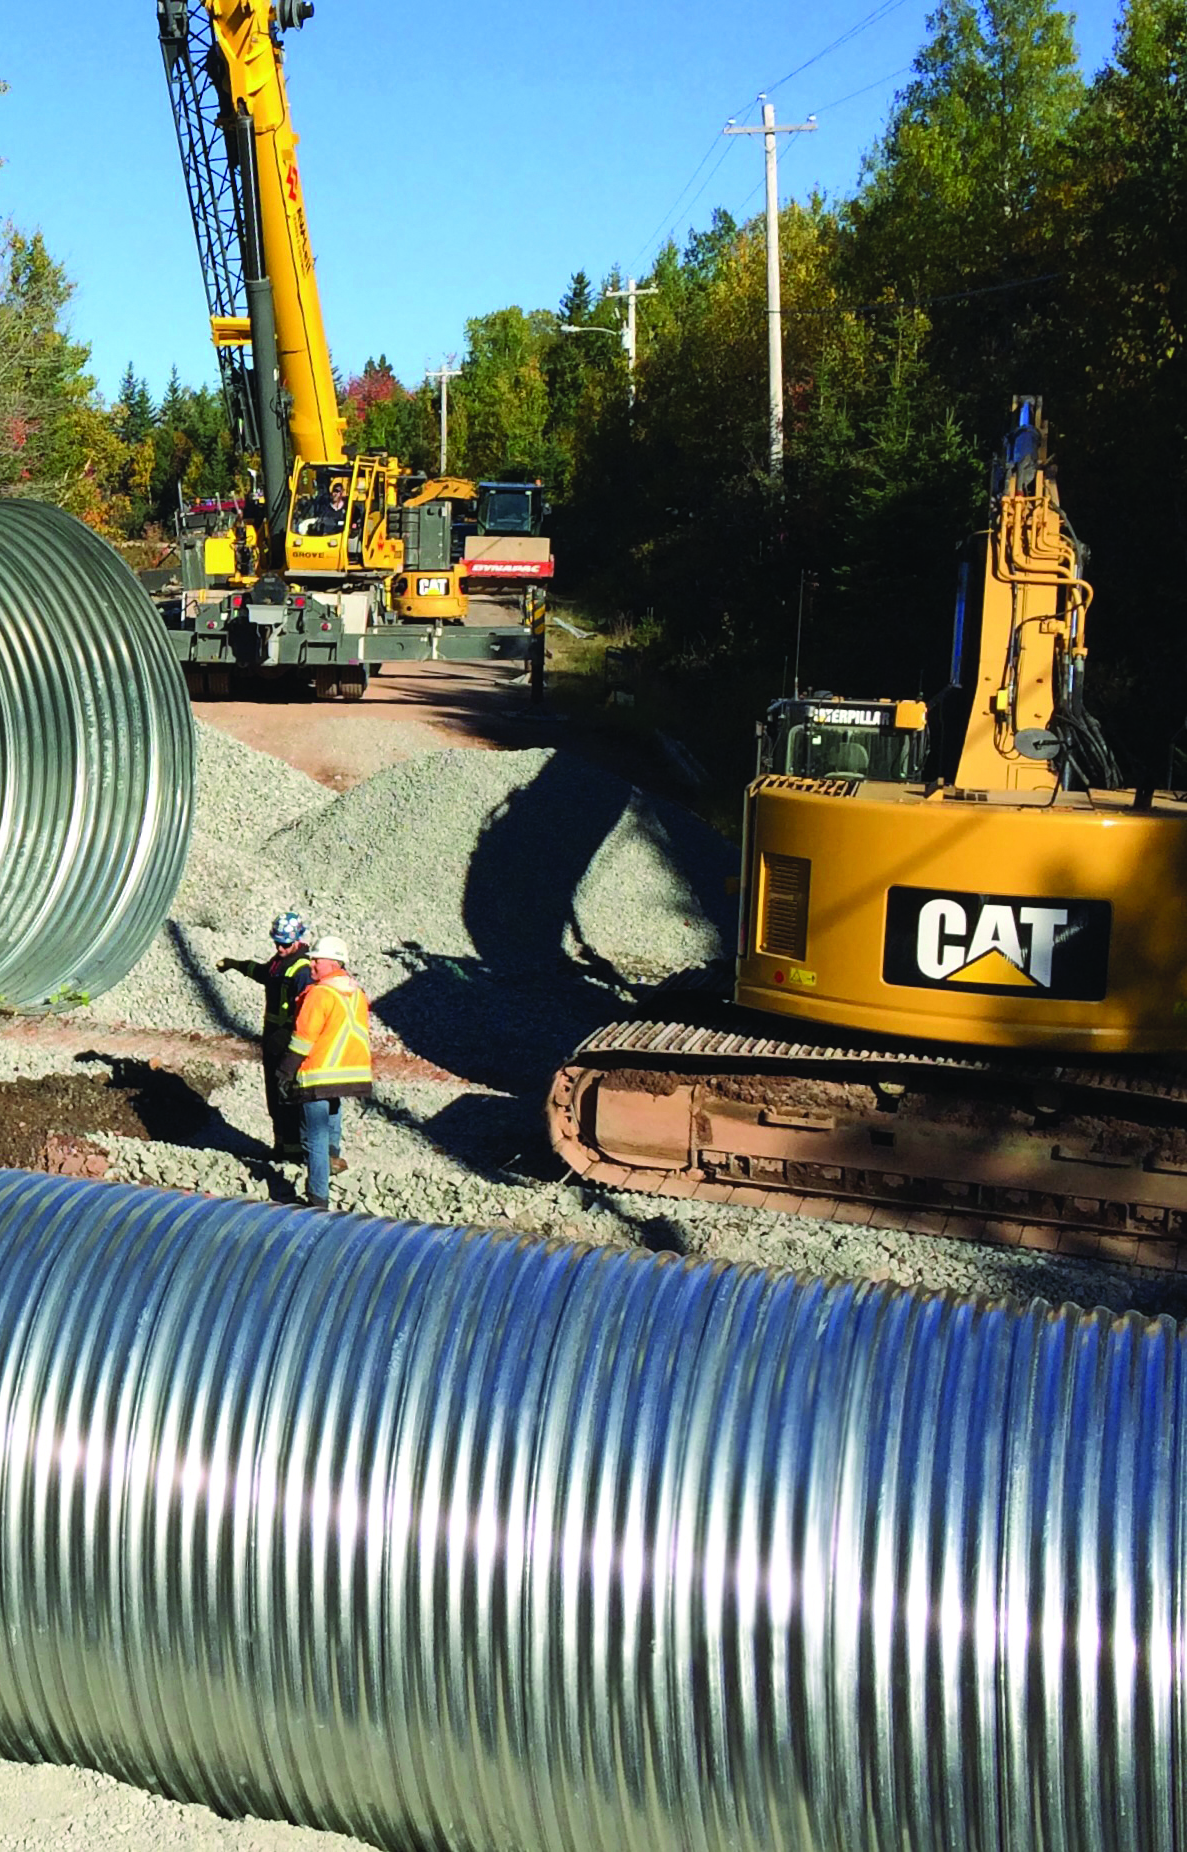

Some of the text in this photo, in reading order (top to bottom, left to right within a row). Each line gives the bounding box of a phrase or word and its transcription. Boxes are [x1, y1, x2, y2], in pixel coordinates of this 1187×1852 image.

[292, 551, 325, 559] GROVE
[471, 563, 542, 573] DYNAPAC
[418, 578, 448, 596] CAT
[917, 898, 1068, 988] CAT
